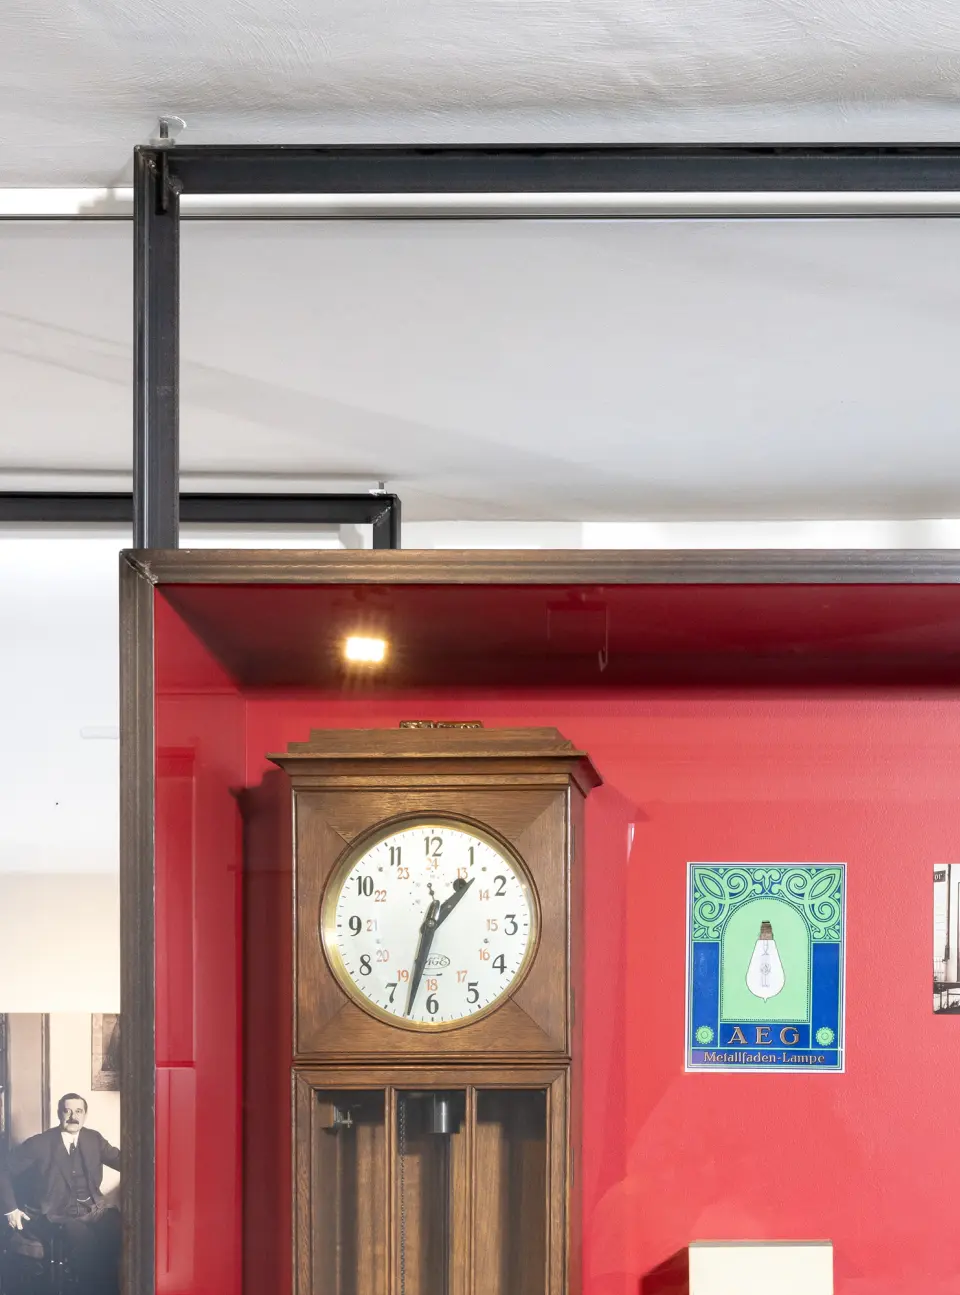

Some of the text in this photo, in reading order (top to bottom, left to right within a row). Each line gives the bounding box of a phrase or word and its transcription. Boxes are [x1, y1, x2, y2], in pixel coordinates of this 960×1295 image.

[424, 837, 443, 857] 12
[389, 846, 402, 866] 11
[425, 858, 439, 870] 24
[467, 847, 474, 866] 1
[397, 868, 410, 879] 23
[457, 867, 468, 879] 13
[356, 876, 374, 896] 10
[494, 876, 506, 896] 2
[374, 890, 386, 902] 22
[479, 889, 490, 901] 14
[349, 915, 362, 936] 9
[366, 919, 378, 932] 21
[486, 919, 498, 931] 15
[504, 914, 518, 935] 3
[376, 950, 389, 962] 20
[479, 949, 490, 960] 16
[359, 954, 372, 975] 8
[492, 954, 507, 974] 4
[397, 970, 409, 982] 19
[457, 970, 467, 982] 17
[385, 982, 398, 1003] 7
[426, 979, 438, 991] 18
[467, 981, 479, 1003] 5
[426, 993, 439, 1014] 6
[727, 1026, 800, 1045] AEG
[704, 1051, 825, 1064] Metallfaden-Lampe
